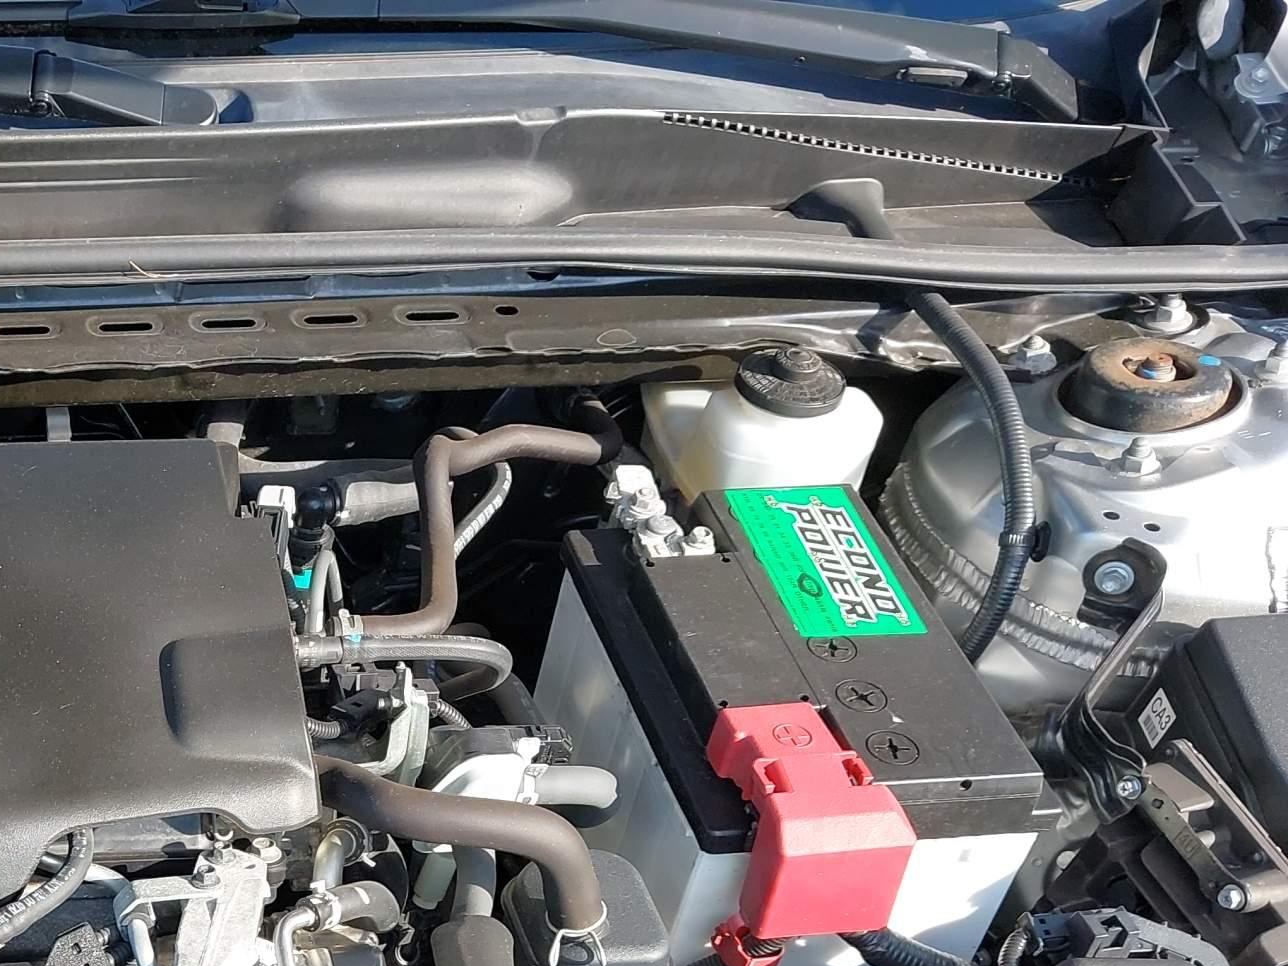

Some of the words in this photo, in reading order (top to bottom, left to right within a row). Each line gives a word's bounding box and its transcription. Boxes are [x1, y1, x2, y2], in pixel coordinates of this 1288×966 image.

[785, 504, 874, 621] POWER
[818, 508, 903, 615] ECONO
[1151, 696, 1171, 731] CA3
